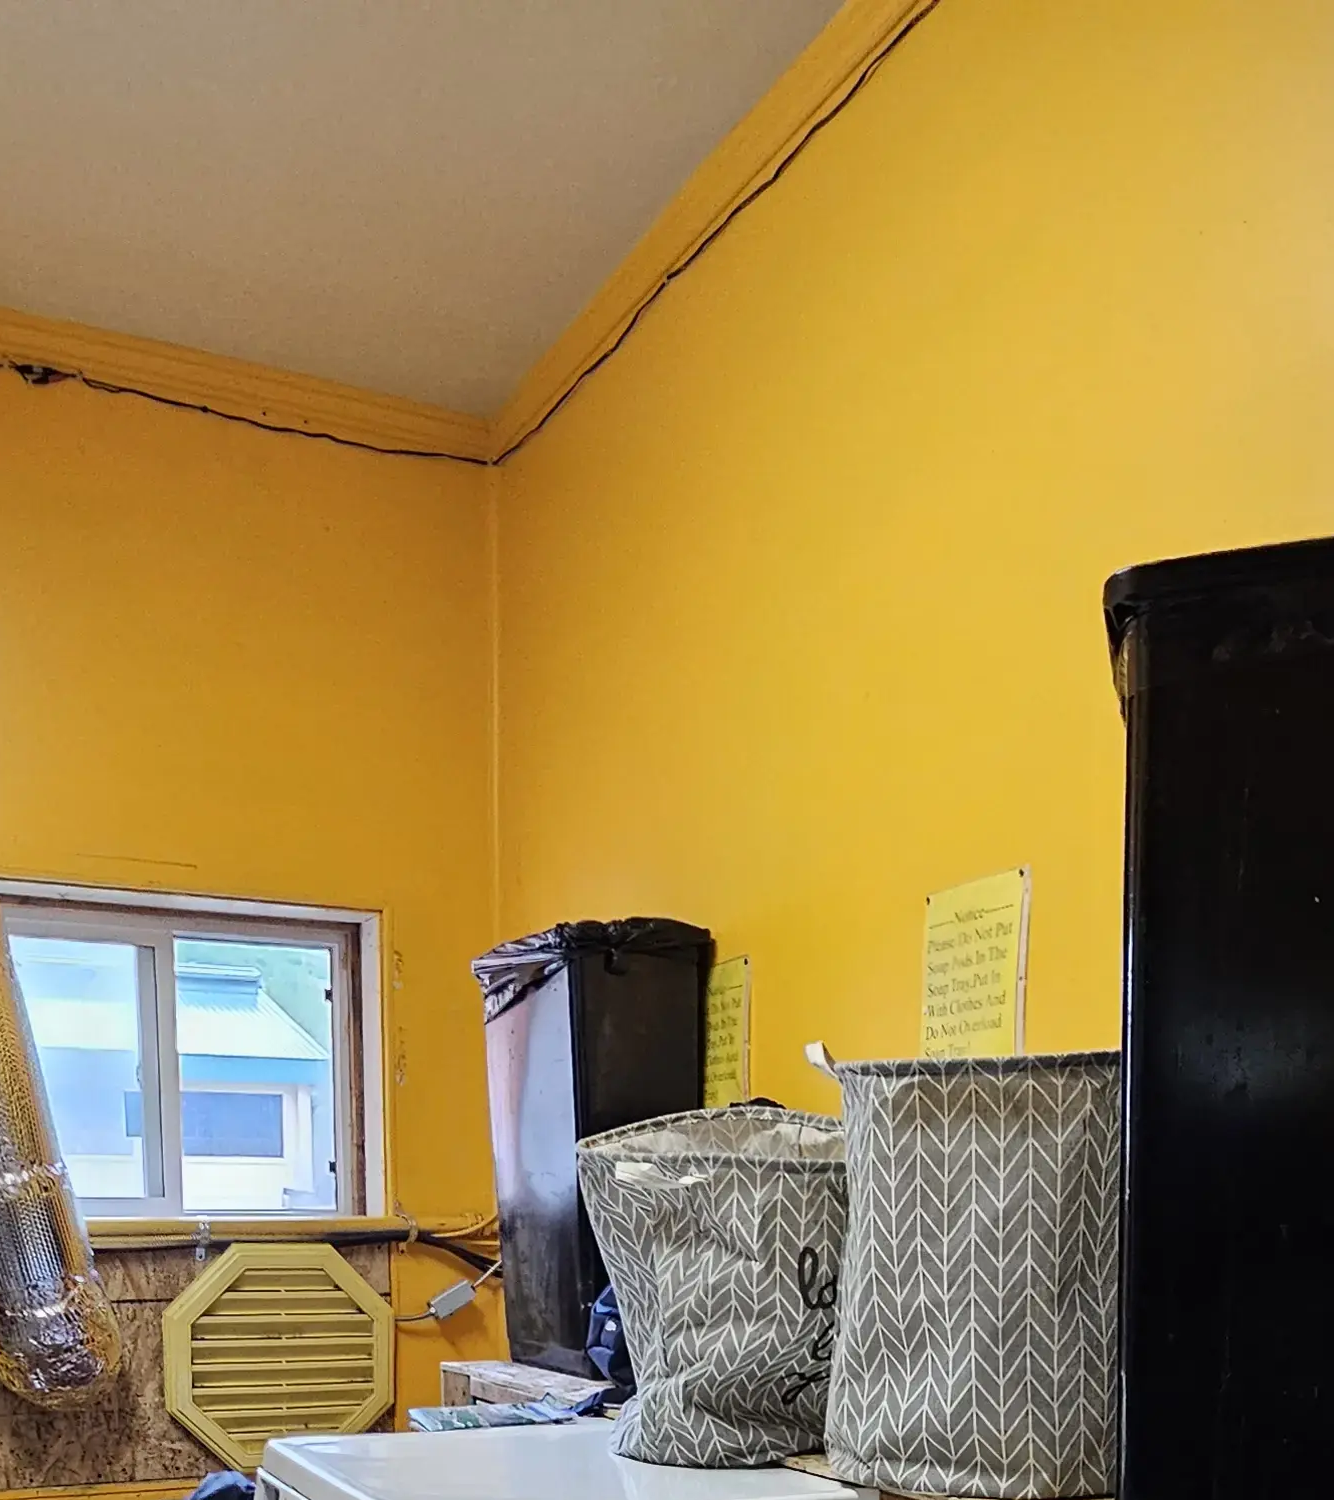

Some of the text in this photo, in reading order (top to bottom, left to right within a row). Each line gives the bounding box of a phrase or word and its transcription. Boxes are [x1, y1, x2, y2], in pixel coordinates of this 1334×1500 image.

[996, 920, 1014, 938] Put
[988, 944, 1008, 962] The
[925, 1024, 939, 1041] Do
